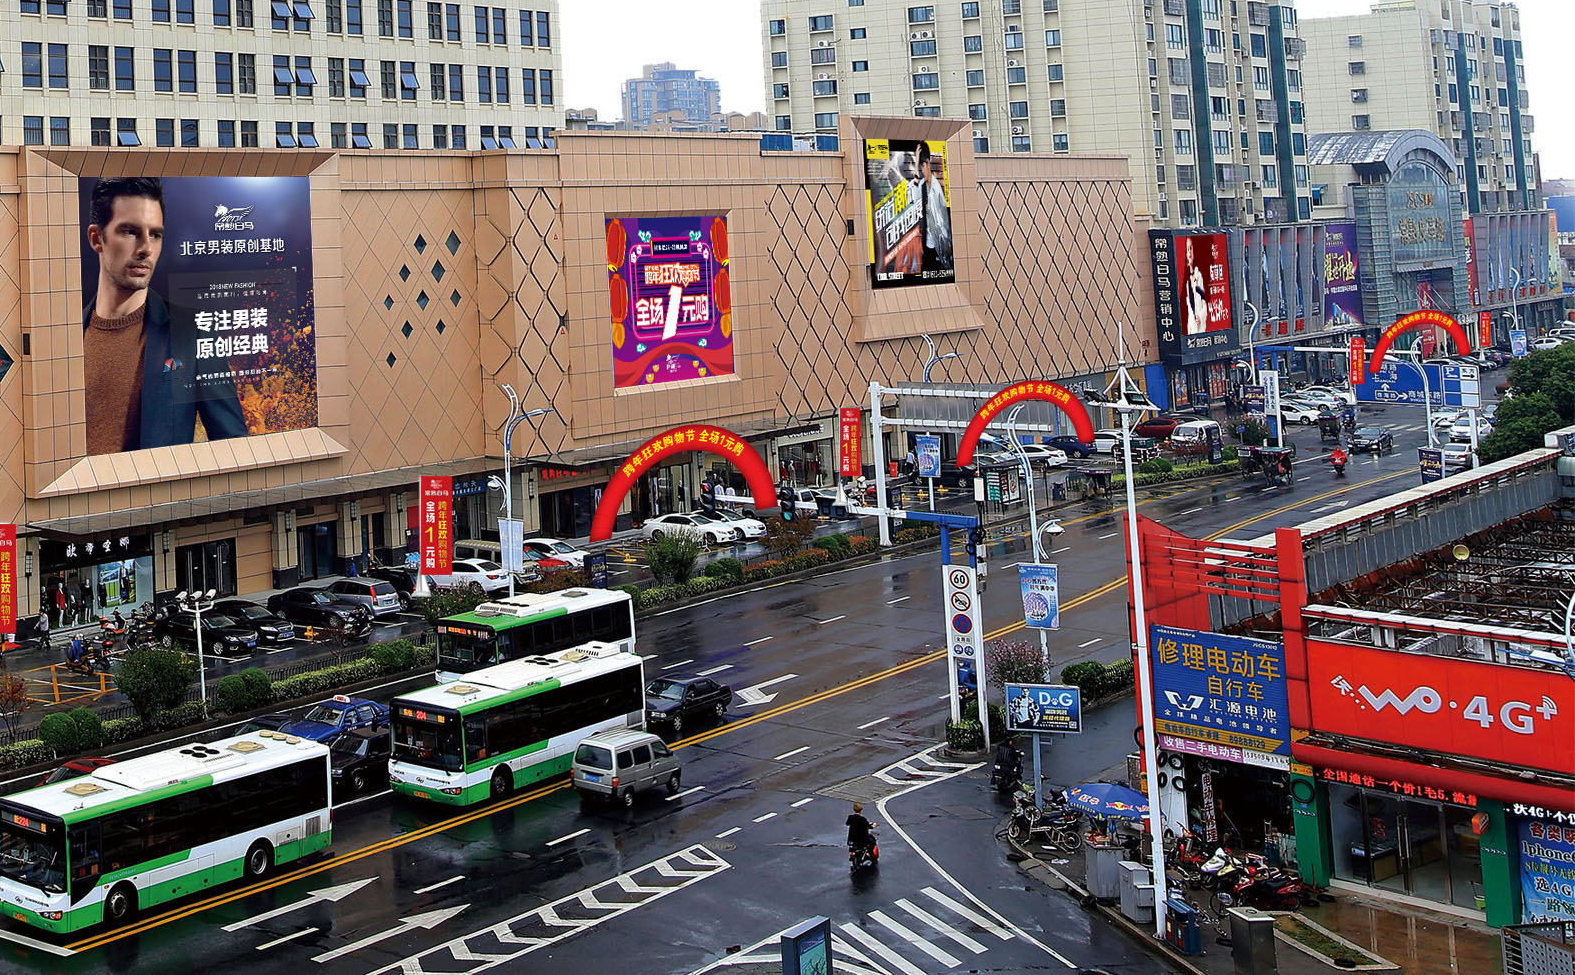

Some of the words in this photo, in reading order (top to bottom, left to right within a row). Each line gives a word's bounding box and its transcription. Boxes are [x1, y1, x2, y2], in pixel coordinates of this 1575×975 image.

[179, 237, 285, 256] 北京男装原创基地
[1154, 238, 1174, 342] 常熟白马营销中心
[194, 307, 268, 332] 专注男装
[635, 285, 709, 341] 全场1元购
[195, 333, 268, 359] 原创经典
[1372, 372, 1398, 380] 上海
[979, 383, 1035, 420] 跨年狂欢购物节
[1036, 383, 1071, 405] 全场1元购
[622, 429, 696, 478] 跨年狂欢购物节
[698, 429, 745, 457] 全场1元购
[842, 425, 850, 472] 全场1元购
[425, 501, 435, 569] 全场1元购
[437, 501, 447, 569] 跨年狂欢购物节
[0, 551, 11, 626] 跨年狂欢购物节
[953, 575, 966, 585] 60
[1157, 637, 1281, 682] 修理电动车
[1208, 675, 1265, 702] 自行车
[416, 710, 427, 721] 204
[1209, 698, 1277, 720] 汇源电池
[1163, 735, 1242, 760] 收售二手电动车
[1202, 775, 1218, 842] 电动车修理
